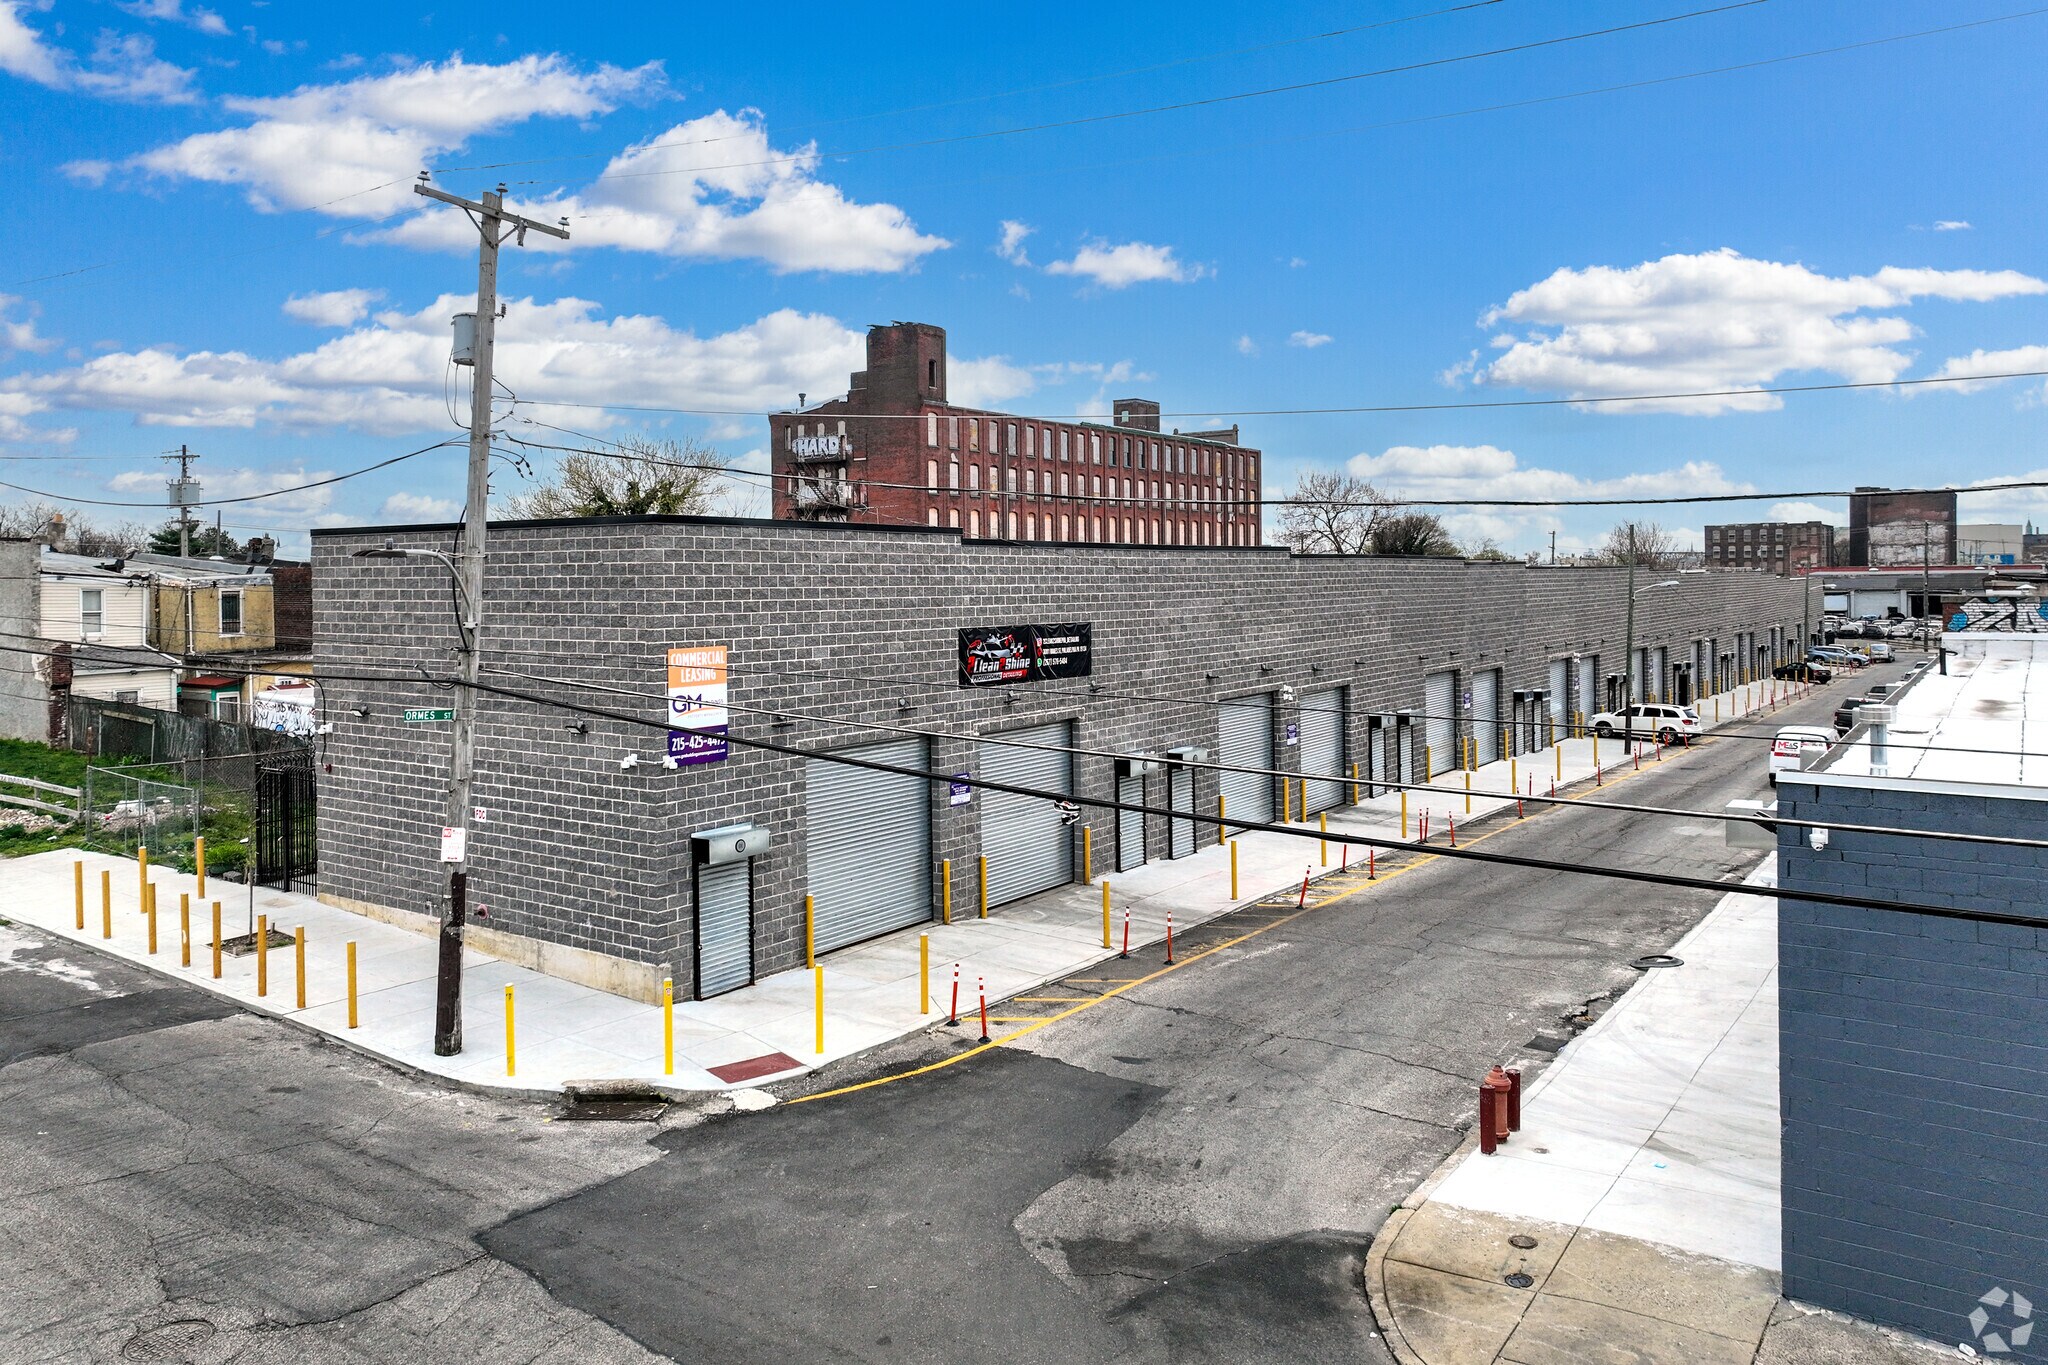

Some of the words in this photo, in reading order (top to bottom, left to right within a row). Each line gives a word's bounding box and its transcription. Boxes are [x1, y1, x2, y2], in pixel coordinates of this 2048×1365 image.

[671, 650, 724, 666] COMMERCIAL
[681, 667, 716, 682] LEASING
[672, 694, 702, 713] GM
[406, 711, 435, 720] ORMES
